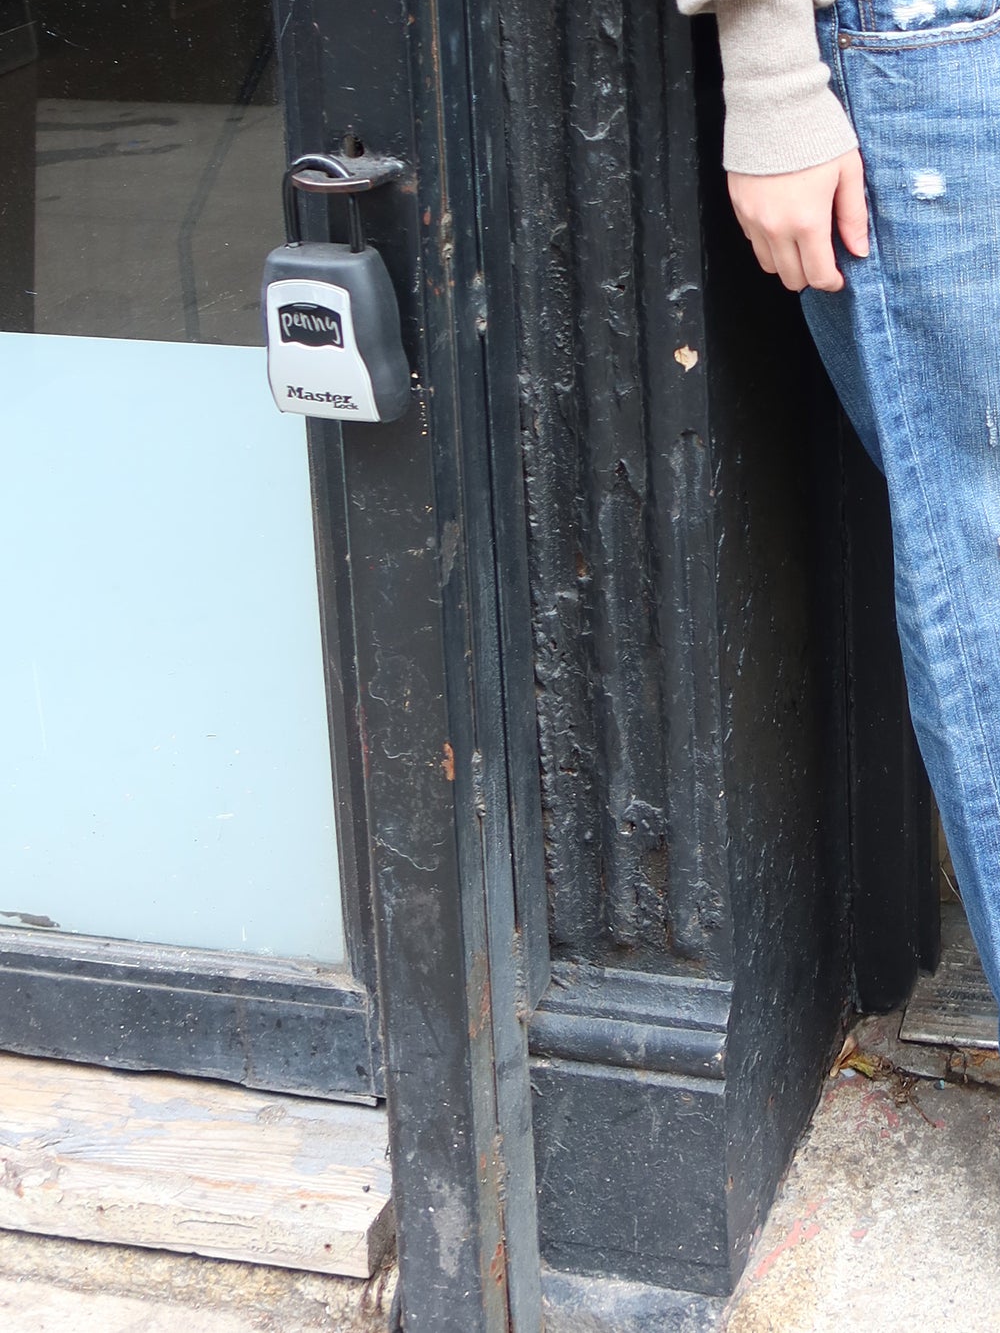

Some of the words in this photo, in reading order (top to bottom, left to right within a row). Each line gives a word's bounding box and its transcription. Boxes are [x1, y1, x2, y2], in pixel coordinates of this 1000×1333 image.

[281, 312, 341, 345] penny
[287, 385, 352, 404] Master
[333, 400, 359, 410] Lock
